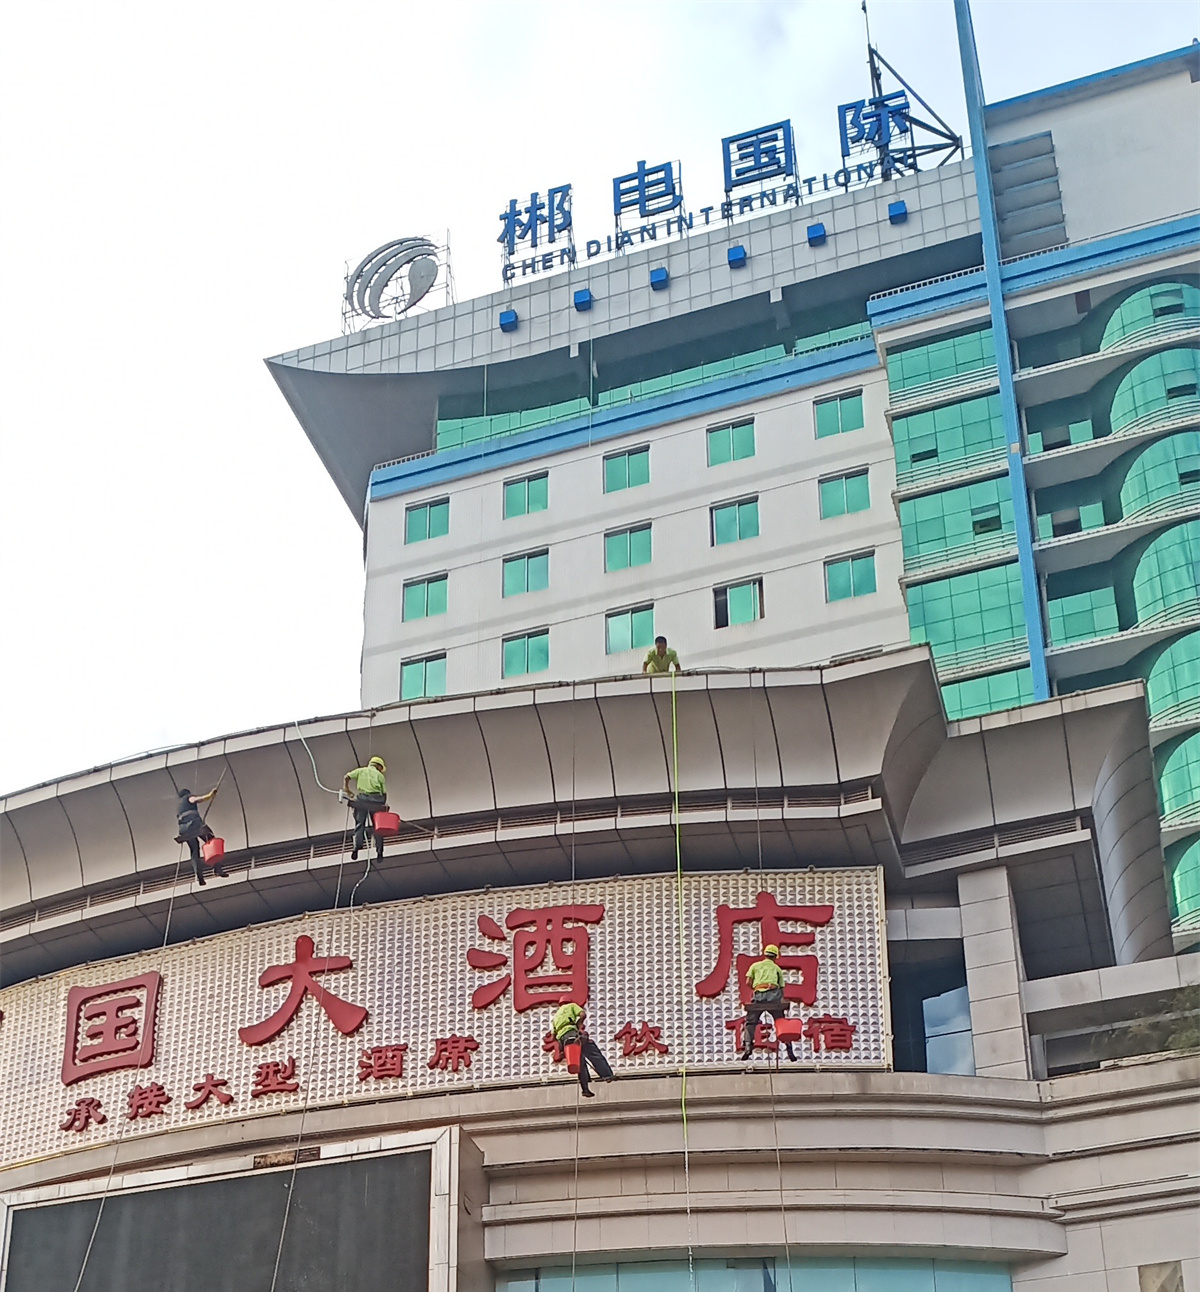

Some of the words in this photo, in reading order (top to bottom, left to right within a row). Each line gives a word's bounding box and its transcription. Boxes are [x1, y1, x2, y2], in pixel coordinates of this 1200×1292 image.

[498, 88, 912, 254] 郴电国际
[502, 248, 576, 281] CHEN
[61, 1056, 300, 1134] 承接大型
[359, 1035, 481, 1083] 酒席
